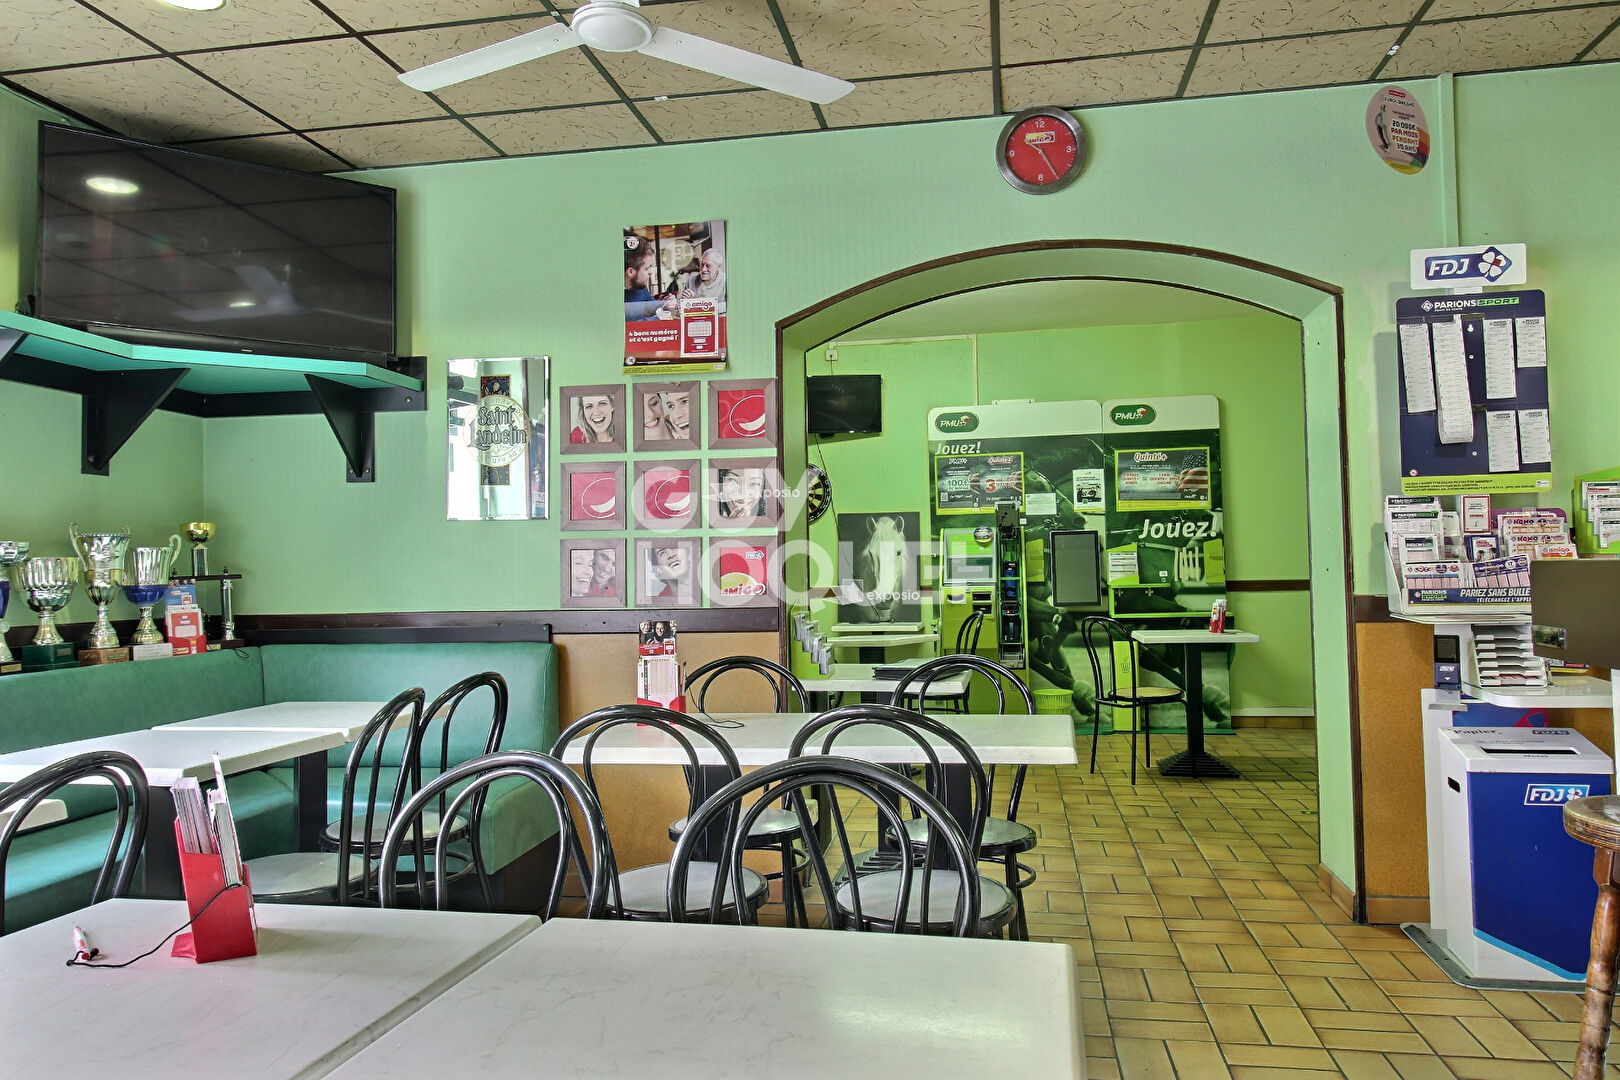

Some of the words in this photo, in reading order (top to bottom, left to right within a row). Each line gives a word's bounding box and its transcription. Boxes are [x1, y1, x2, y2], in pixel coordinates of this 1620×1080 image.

[1034, 120, 1045, 129] 12
[1066, 145, 1072, 153] 3
[1428, 257, 1470, 277] FDJ
[1434, 299, 1477, 309] PARIONS
[1478, 296, 1518, 306] SPORT
[477, 405, 516, 426] Saint
[1115, 411, 1137, 420] PMU
[940, 419, 960, 428] PMU
[467, 424, 527, 451] Landelin
[935, 441, 982, 456] Jouez!
[984, 478, 997, 492] 3
[1138, 514, 1218, 539] Jouez!
[1460, 588, 1487, 597] PARIEZ
[1487, 588, 1508, 597] SANS
[1529, 787, 1565, 802] FDJ
